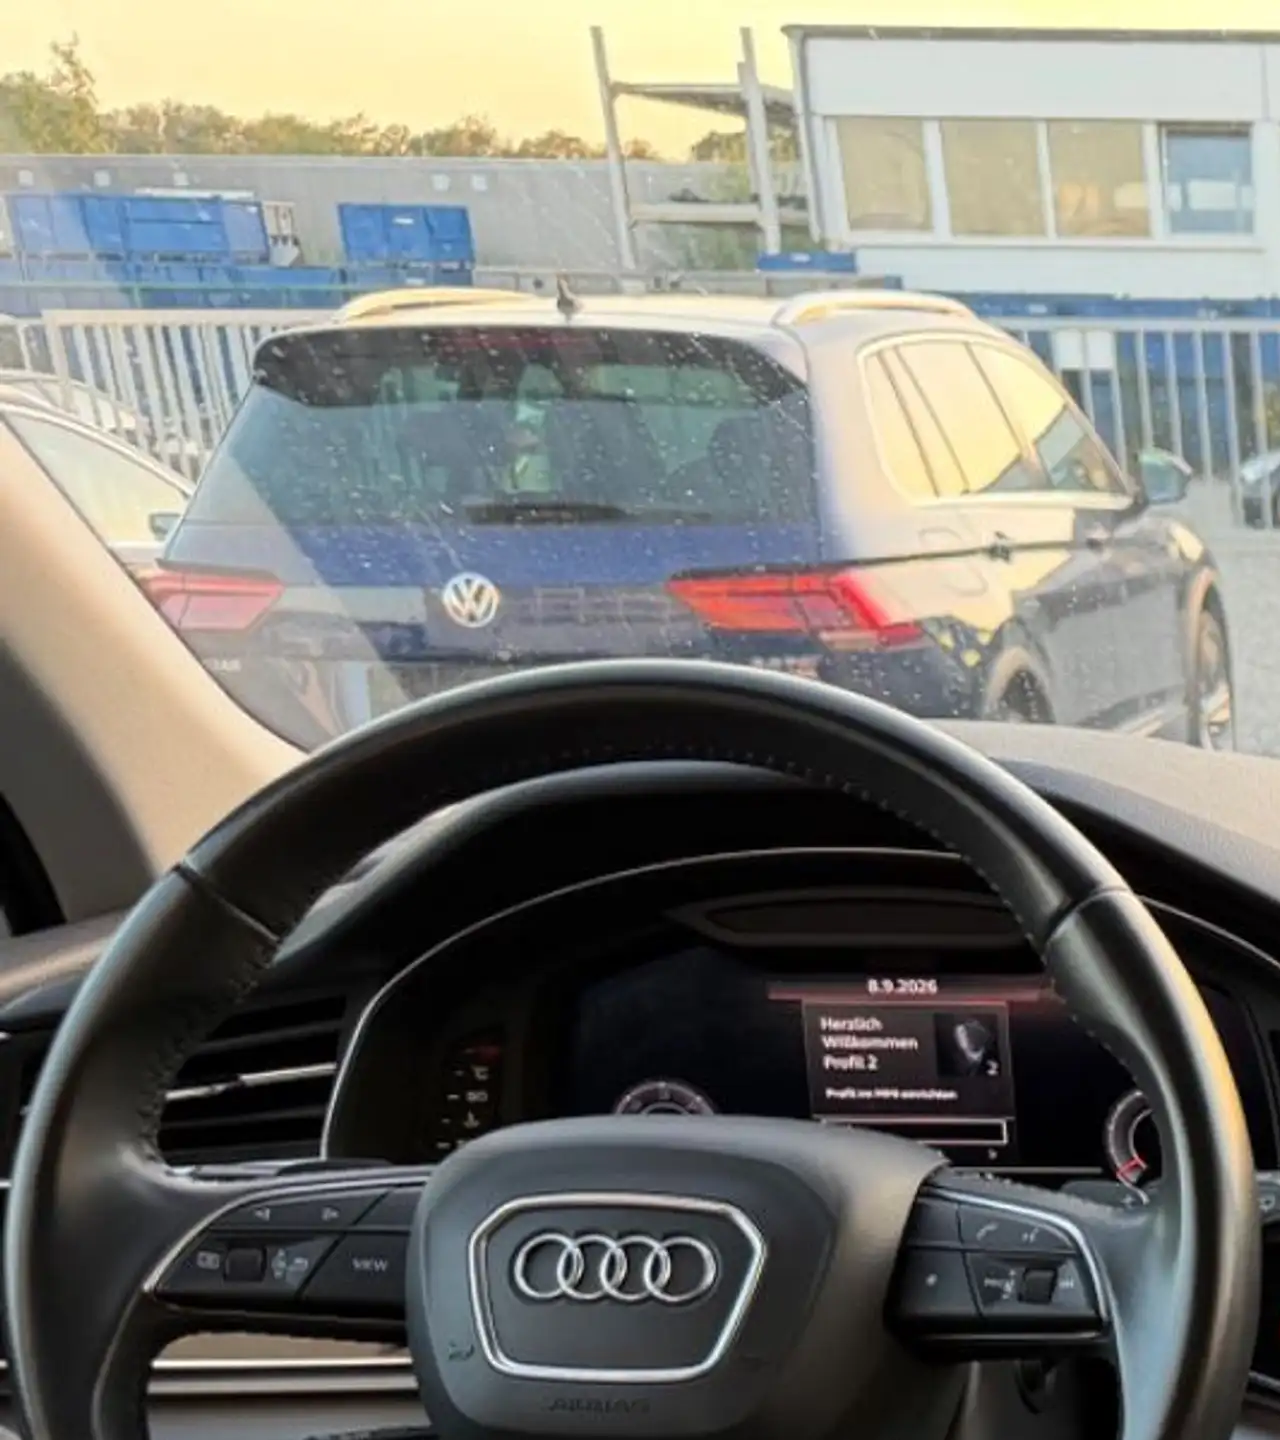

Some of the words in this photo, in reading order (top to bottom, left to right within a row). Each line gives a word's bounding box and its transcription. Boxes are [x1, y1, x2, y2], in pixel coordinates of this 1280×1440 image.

[867, 979, 938, 994] 8.9.2026
[820, 1016, 883, 1032] Herzlich
[820, 1034, 919, 1050] Willkommen
[823, 1053, 865, 1071] Profil
[867, 1053, 878, 1071] 2
[986, 1061, 999, 1076] 2
[352, 1257, 388, 1272] VIEW
